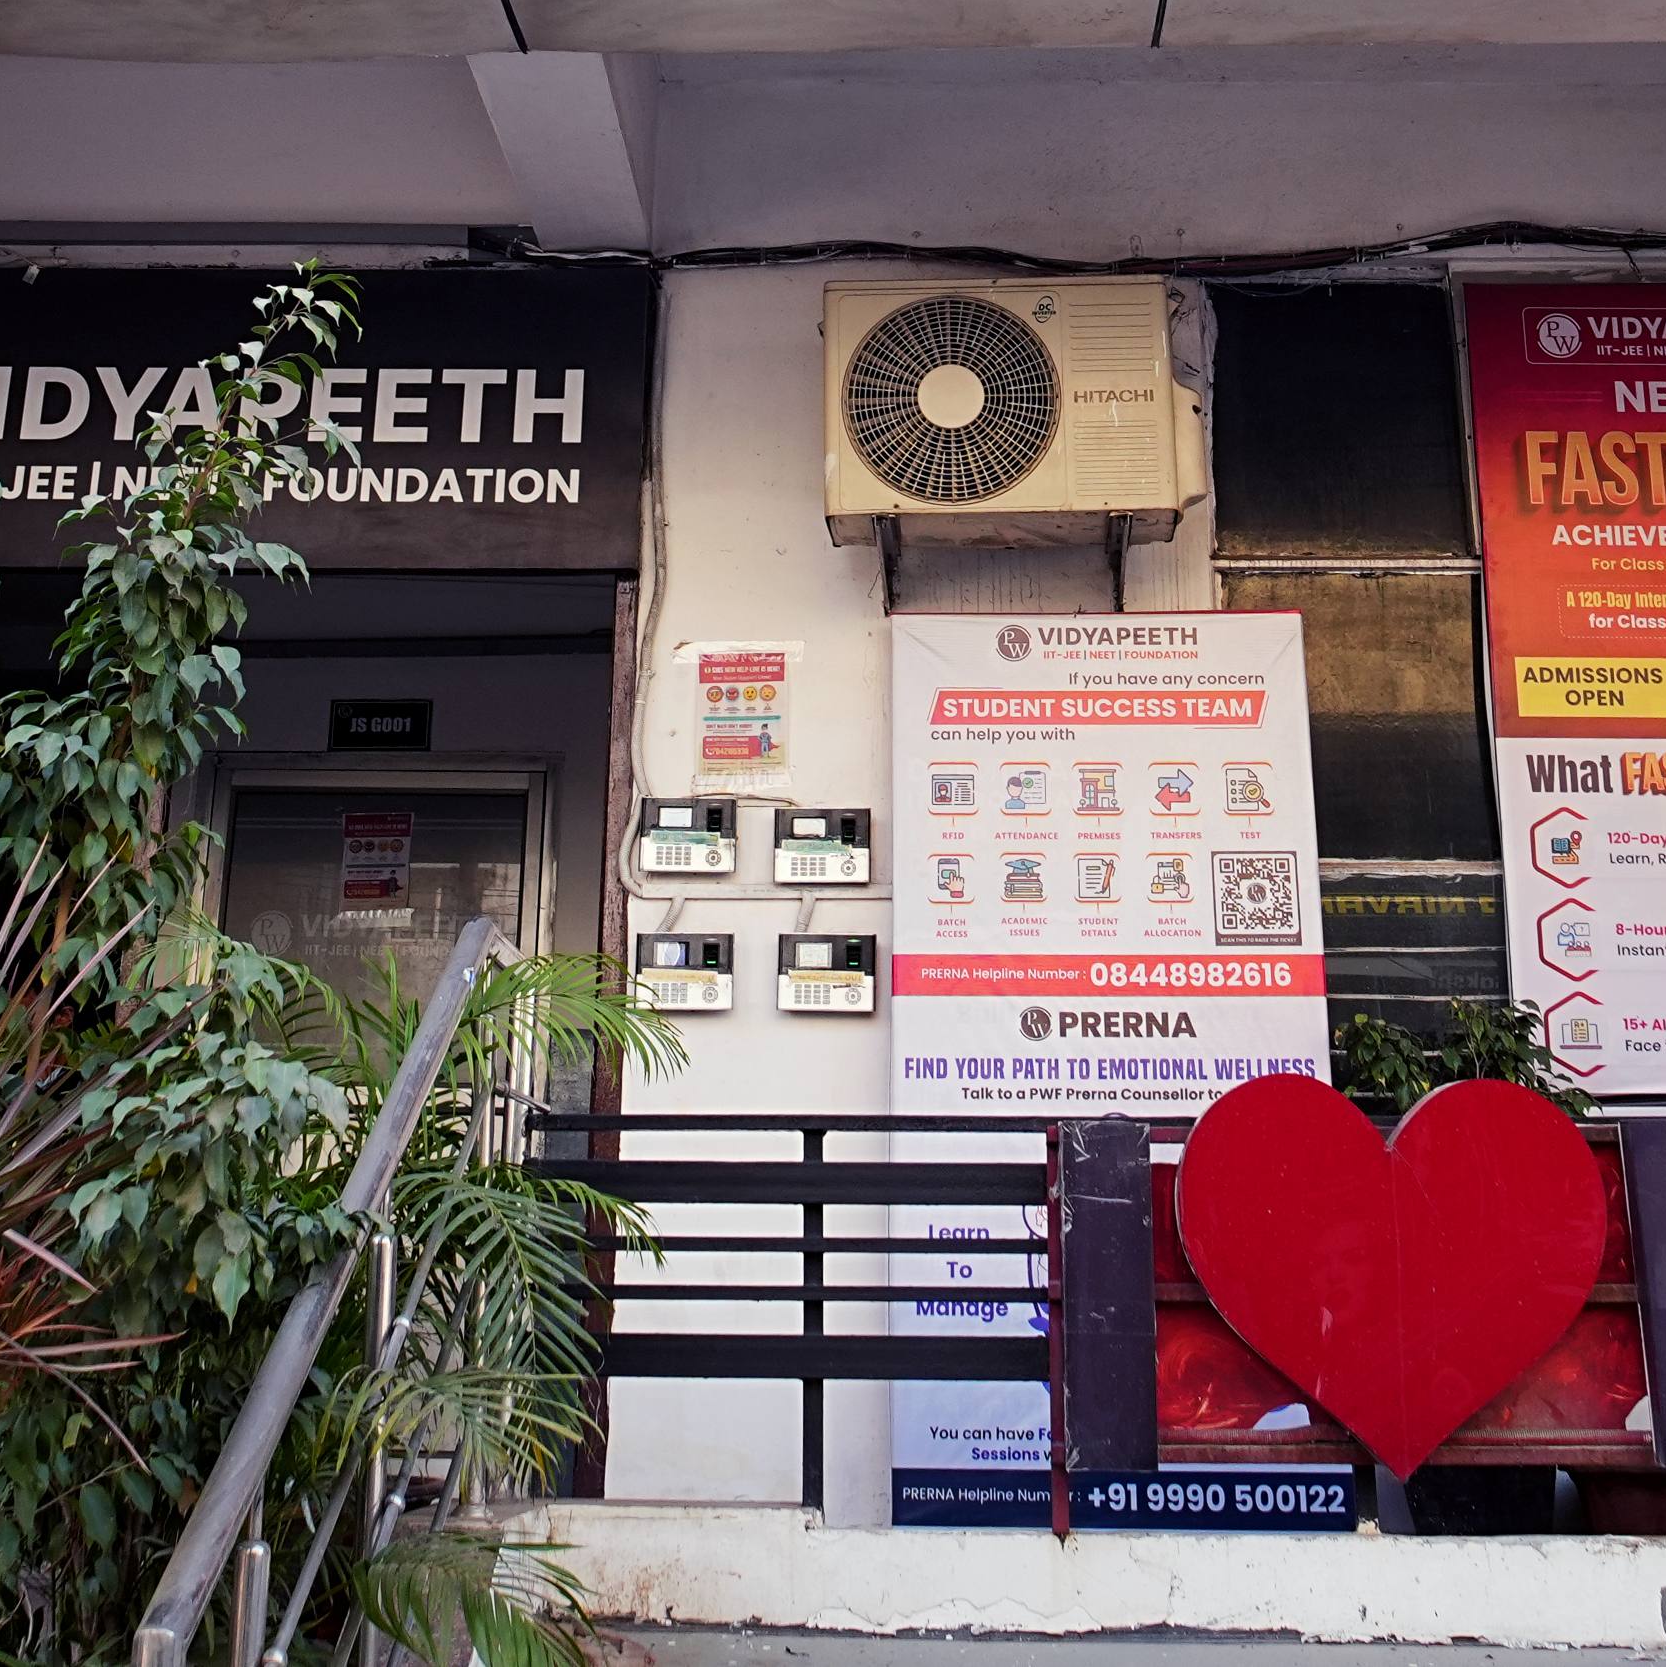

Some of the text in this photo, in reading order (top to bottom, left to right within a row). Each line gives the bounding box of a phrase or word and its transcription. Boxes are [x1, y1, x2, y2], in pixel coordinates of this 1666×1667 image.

[1038, 303, 1051, 312] DC
[1597, 345, 1644, 356] IIT-JEE
[1074, 389, 1154, 403] HITACHI
[264, 468, 580, 503] FOUNDATION
[1579, 592, 1631, 610] 120-Day
[1039, 627, 1198, 645] VIDYAPEETH
[1043, 650, 1198, 660] IIT-JEE NEET FOUNDATION
[1069, 672, 1264, 688] If you have any concern
[1523, 667, 1663, 684] ADMISSIONS
[1565, 689, 1624, 707] OPEN
[943, 699, 1252, 717] STUDENT SUCCESS TEAM
[350, 718, 367, 733] JS
[931, 728, 1075, 743] can help you with
[1527, 755, 1613, 793] What
[942, 831, 1260, 840] RFID ATTENDANCE PREMISES TRANSFERS TEST
[922, 963, 1292, 987] PRERNA Helpline Number 08448982616
[1059, 1012, 1197, 1037] PRERNA
[1623, 1019, 1648, 1031] 15+
[1625, 1040, 1660, 1052] Face
[905, 1058, 1315, 1080] FIND YOUR PATH TO EMOTIONAL WELLNESS
[962, 1088, 1203, 1100] Talk PWF Prerna Counsellor
[971, 1447, 1039, 1461] Sessions
[1087, 1483, 1345, 1512] +91 9990 500122
